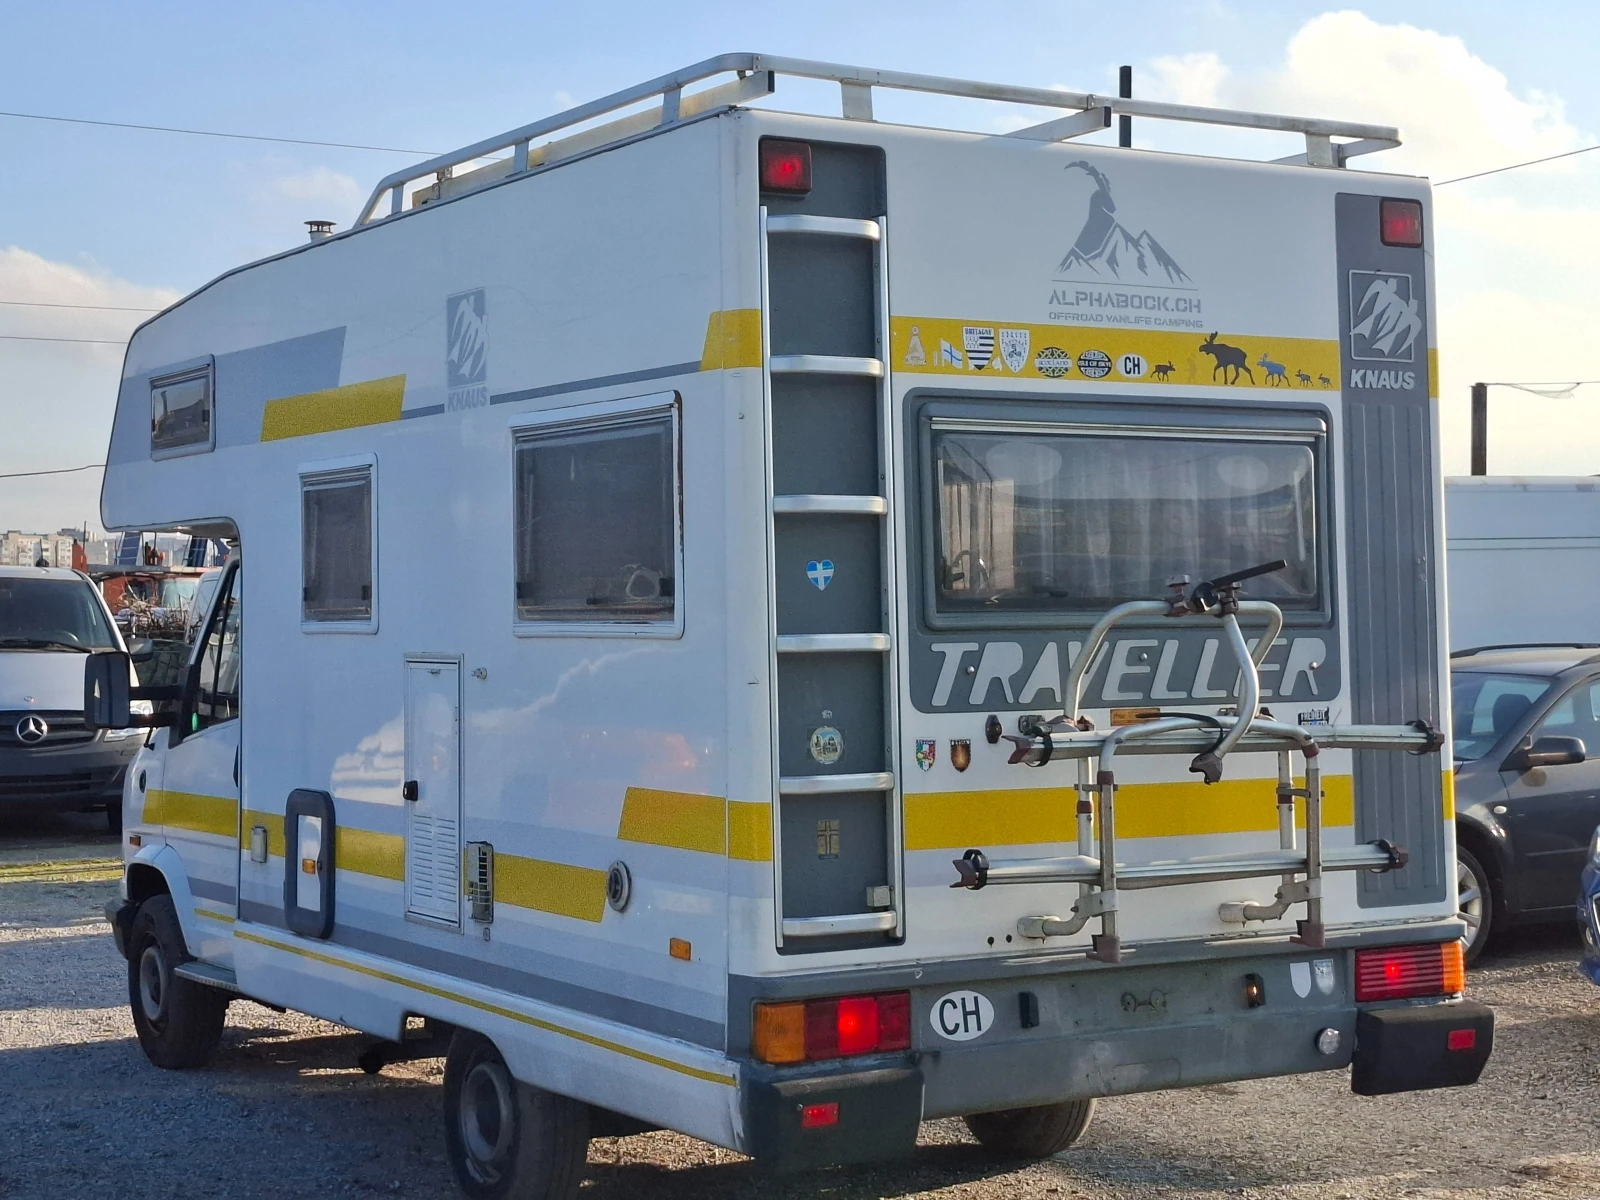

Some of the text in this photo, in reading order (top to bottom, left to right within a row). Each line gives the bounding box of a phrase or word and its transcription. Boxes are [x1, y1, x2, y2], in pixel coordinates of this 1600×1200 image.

[1048, 288, 1202, 314] ALPHABOCK.CH
[1048, 311, 1204, 329] OFFROAD VANLIFE CAMPING
[1124, 355, 1141, 375] CH
[1350, 368, 1416, 390] KNAUS
[447, 386, 488, 413] KNAUS
[938, 995, 982, 1036] CH
